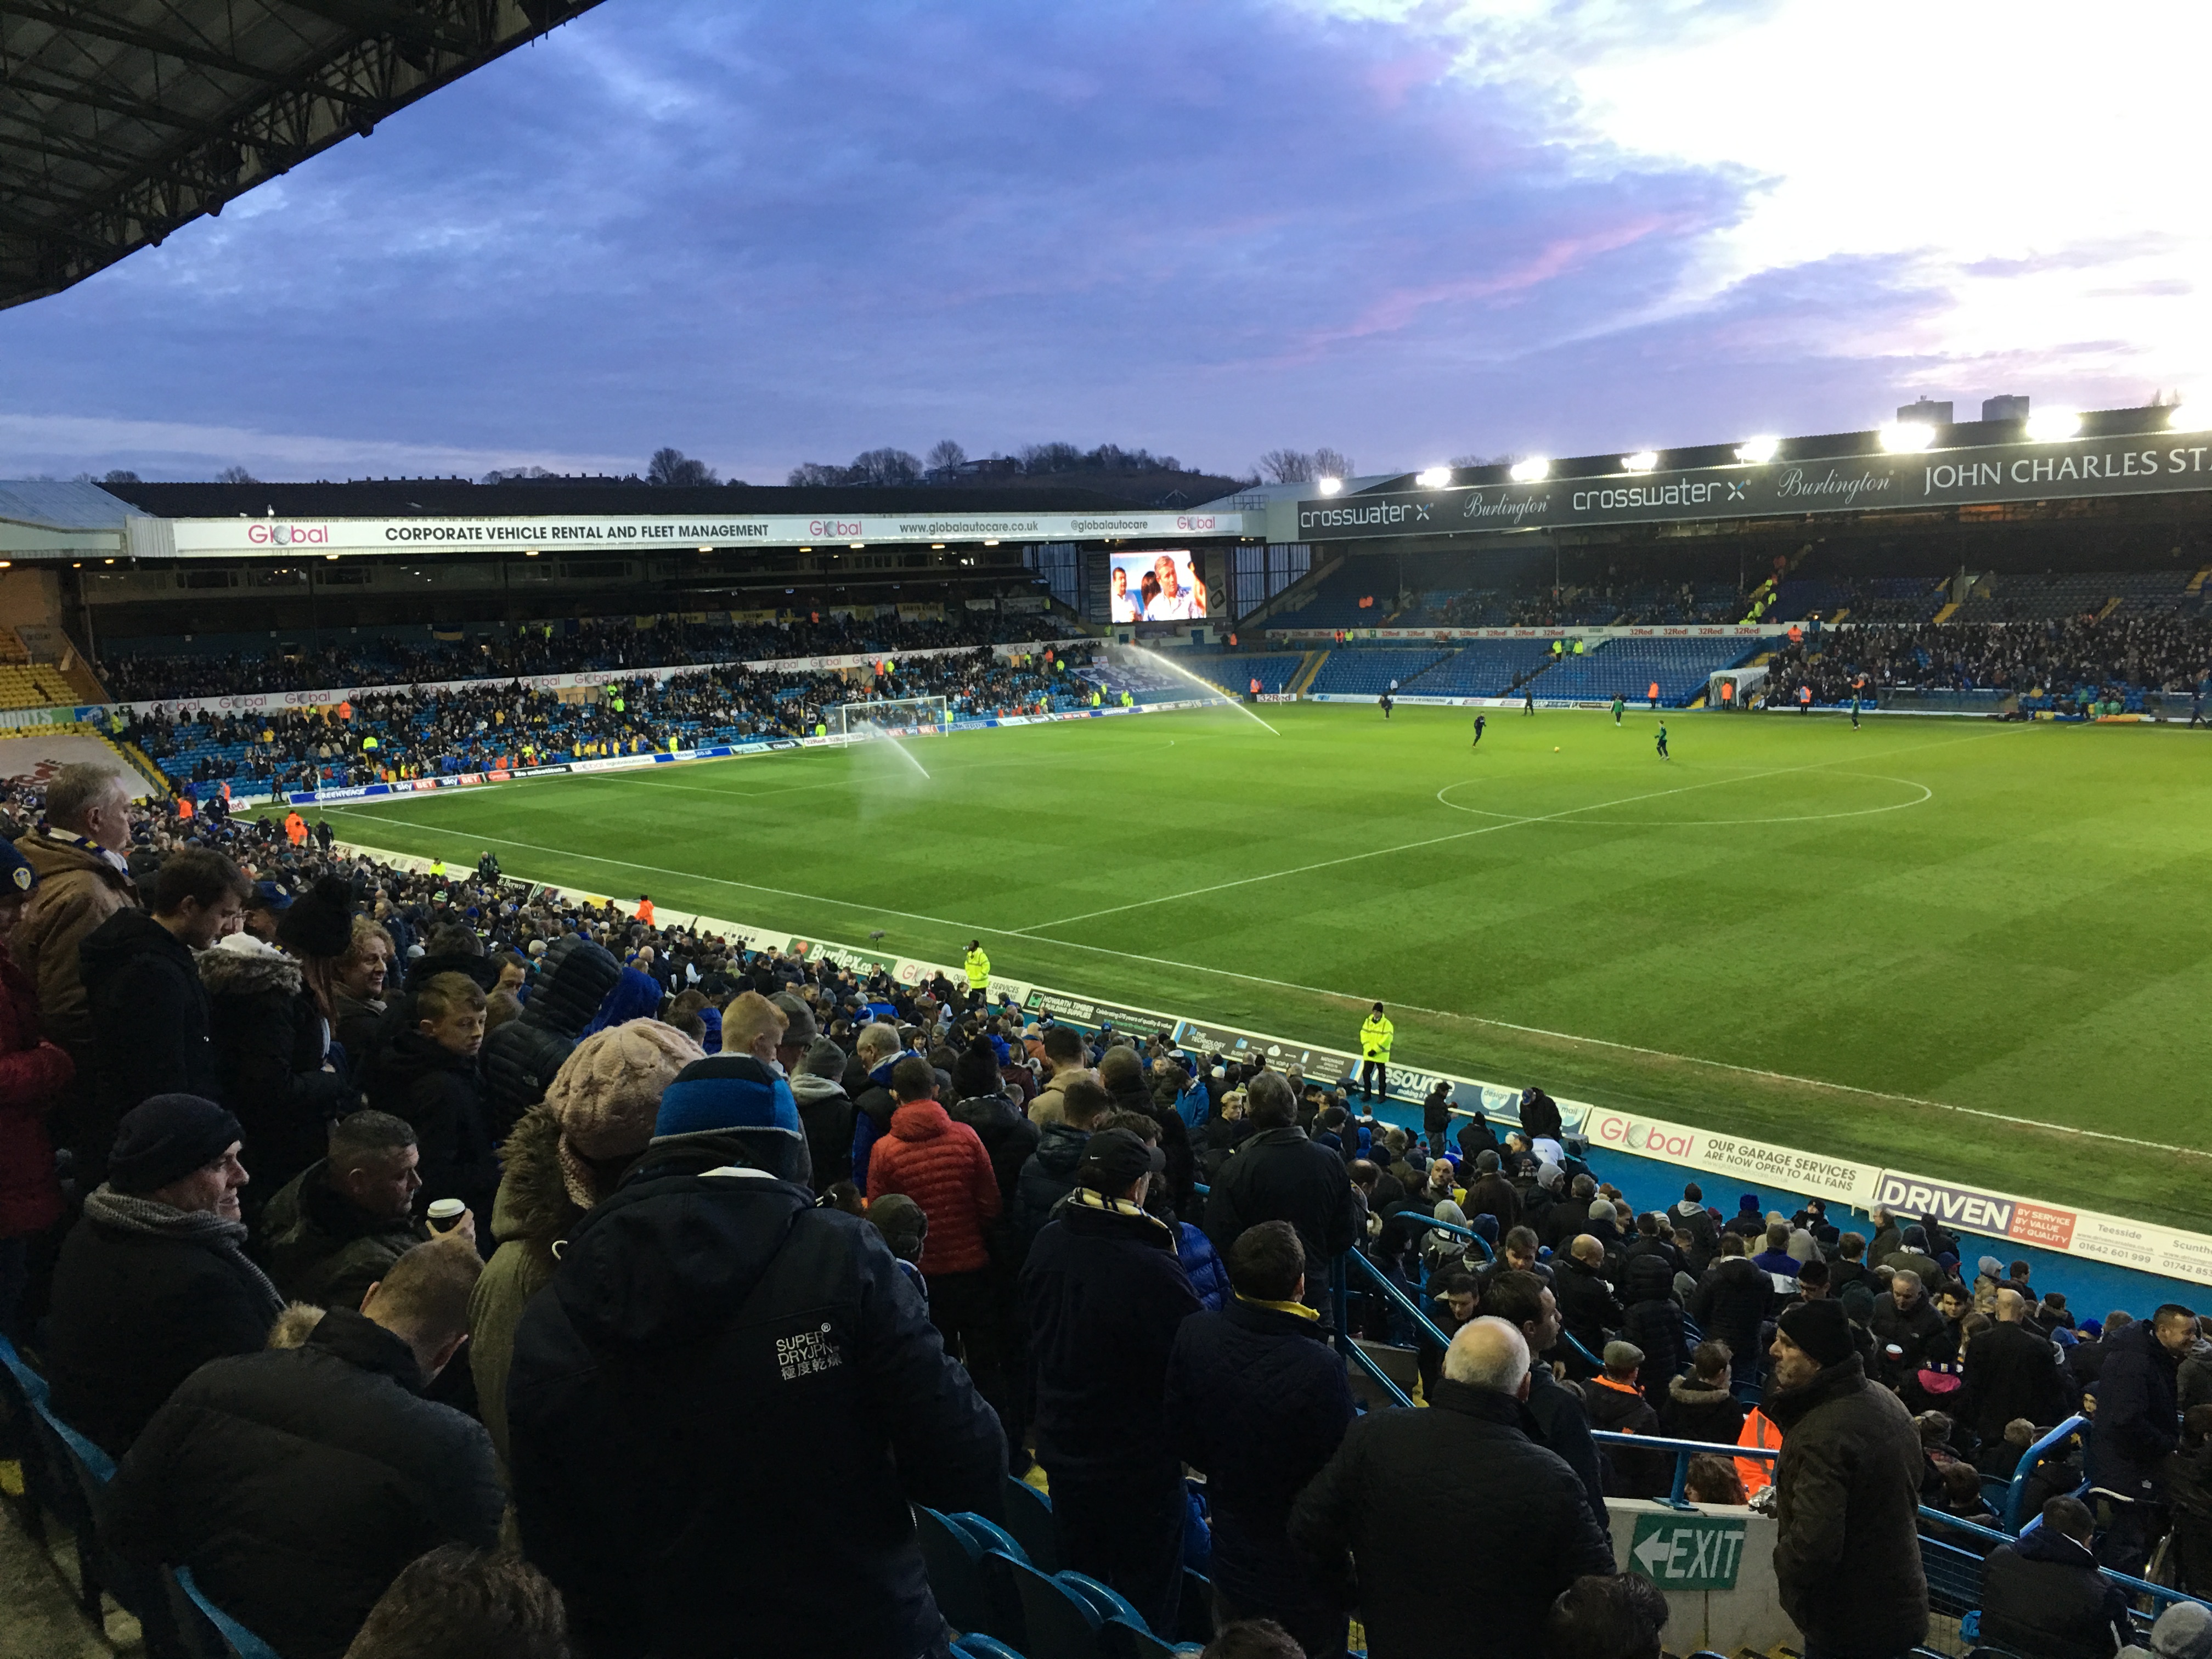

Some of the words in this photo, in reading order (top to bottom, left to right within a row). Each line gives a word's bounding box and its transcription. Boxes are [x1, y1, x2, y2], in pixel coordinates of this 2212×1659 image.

[1925, 462, 2002, 495] JOHN
[2011, 450, 2159, 482] CHARLES
[2169, 447, 2212, 472] ST
[1573, 478, 1722, 511] crosswater
[1778, 469, 1890, 504] Burlington
[1301, 501, 1412, 528] crosswater
[1464, 492, 1548, 524] Burlington
[809, 520, 862, 537] Global
[900, 521, 1039, 535] www.globalautocare.co.uk
[1177, 516, 1216, 531] Global
[249, 524, 329, 544] Global
[386, 527, 483, 541] CORPORATE
[487, 527, 548, 540] VEHICLE
[552, 526, 603, 539] RENTAL
[607, 526, 637, 538] AND
[641, 526, 675, 538] FLEET
[678, 524, 769, 538] MANAGEMENT
[810, 657, 841, 667] Global
[522, 675, 560, 687] Global
[574, 673, 612, 684] Global
[219, 695, 267, 709] Global
[285, 690, 331, 704] Global
[527, 766, 567, 776] substitute
[396, 783, 413, 792] sky
[416, 780, 433, 789] BET
[442, 777, 458, 786] sky
[461, 775, 478, 784] BET
[314, 788, 366, 800] GREENPEACE
[504, 878, 526, 890] Berwin
[953, 974, 966, 983] OUR
[991, 981, 1020, 994] SERVICES
[1043, 995, 1072, 1008] HOWARTH
[1073, 1002, 1094, 1013] TIMBER
[1045, 1003, 1068, 1014] BUILDING
[1067, 1008, 1092, 1020] SUPPLIES
[1191, 1035, 1226, 1048] TECHNOLOGY
[1397, 1088, 1419, 1099] making
[1483, 1089, 1507, 1100] design
[1560, 1106, 1578, 1115] mail
[1600, 1118, 1694, 1158] Global
[1708, 1138, 1735, 1153] OUR
[1738, 1146, 1793, 1166] GARAGE
[1795, 1158, 1857, 1181] SERVICES
[1704, 1150, 1724, 1161] ARE
[1726, 1154, 1753, 1167] NOW
[1755, 1161, 1785, 1175] OPEN
[1787, 1169, 1801, 1179] TO
[1803, 1172, 1821, 1184] ALL
[1825, 1177, 1853, 1191] FANS
[1882, 1179, 2011, 1231] DRIVEN
[2015, 1216, 2028, 1225] BY
[2030, 1220, 2059, 1233] VALUE
[2017, 1208, 2031, 1217] BY
[2032, 1211, 2071, 1226] SERVICE
[2012, 1225, 2025, 1234] BY
[2027, 1229, 2068, 1244] QUALITY
[2097, 1223, 2142, 1240] Teesside
[2079, 1242, 2108, 1254] 01642
[2111, 1248, 2129, 1259] 601
[2131, 1252, 2151, 1264] 999
[2162, 1260, 2193, 1273] 01742
[776, 1331, 825, 1352] SUPER
[1664, 1528, 1745, 1578] EXIT
